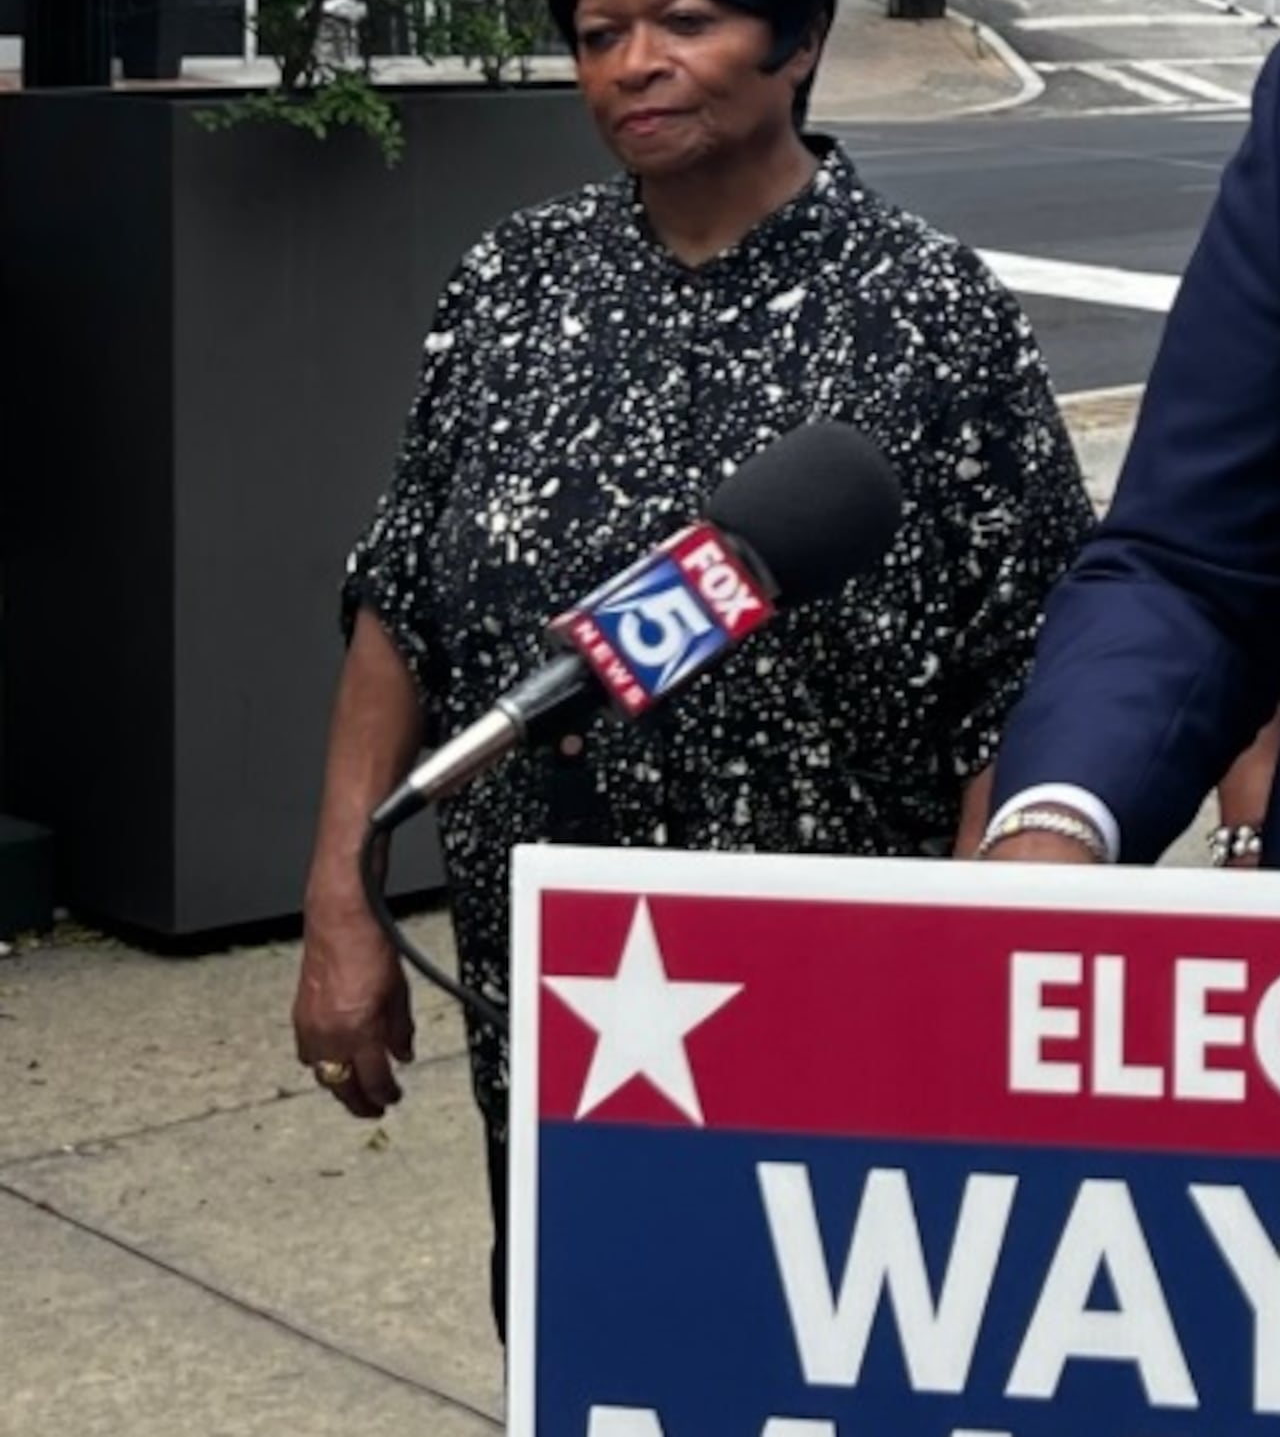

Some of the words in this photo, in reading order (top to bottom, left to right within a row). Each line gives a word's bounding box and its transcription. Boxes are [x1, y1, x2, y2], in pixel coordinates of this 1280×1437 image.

[617, 585, 714, 667] 5
[680, 538, 765, 631] FOX
[573, 619, 649, 707] NEWS
